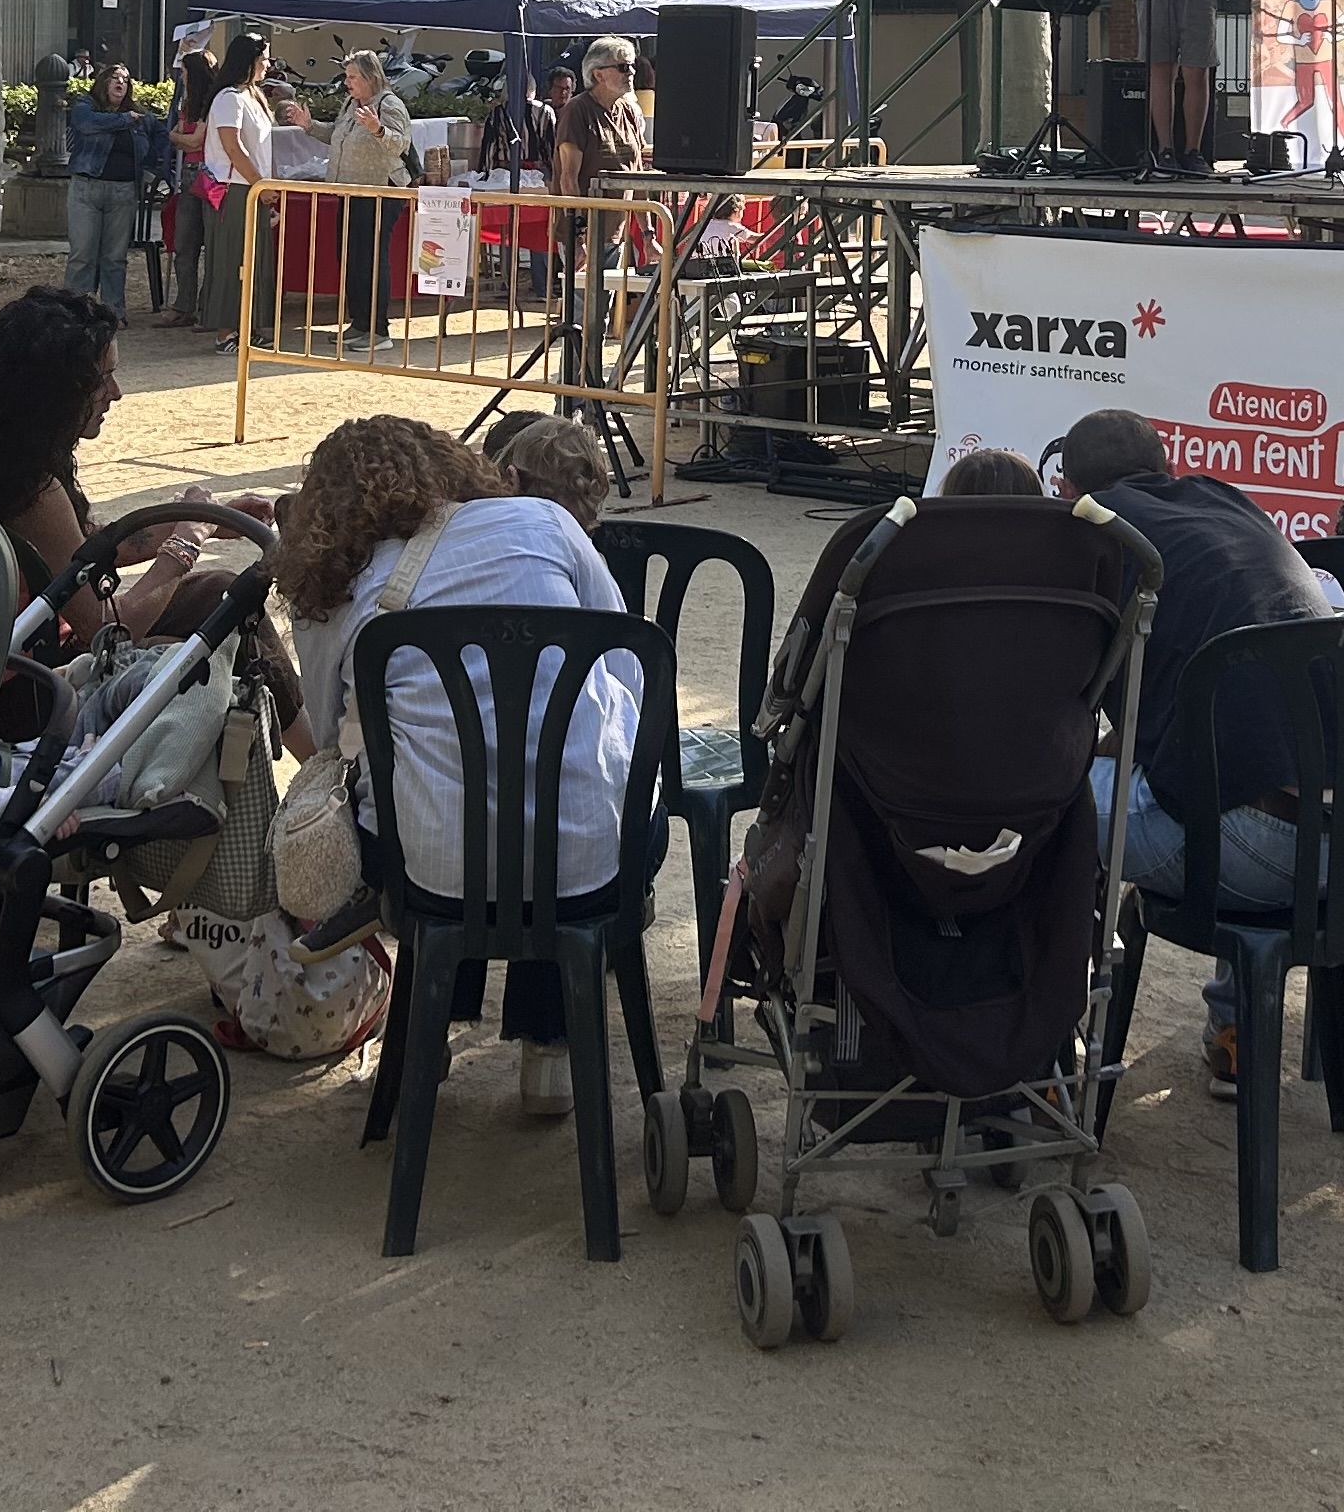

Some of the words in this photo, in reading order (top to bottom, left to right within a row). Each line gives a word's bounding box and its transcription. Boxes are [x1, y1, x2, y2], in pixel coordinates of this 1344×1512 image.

[965, 311, 1127, 358] xarxa
[953, 356, 1026, 376] monestir
[1030, 364, 1126, 384] santfrancesc
[185, 914, 246, 950] digo.
